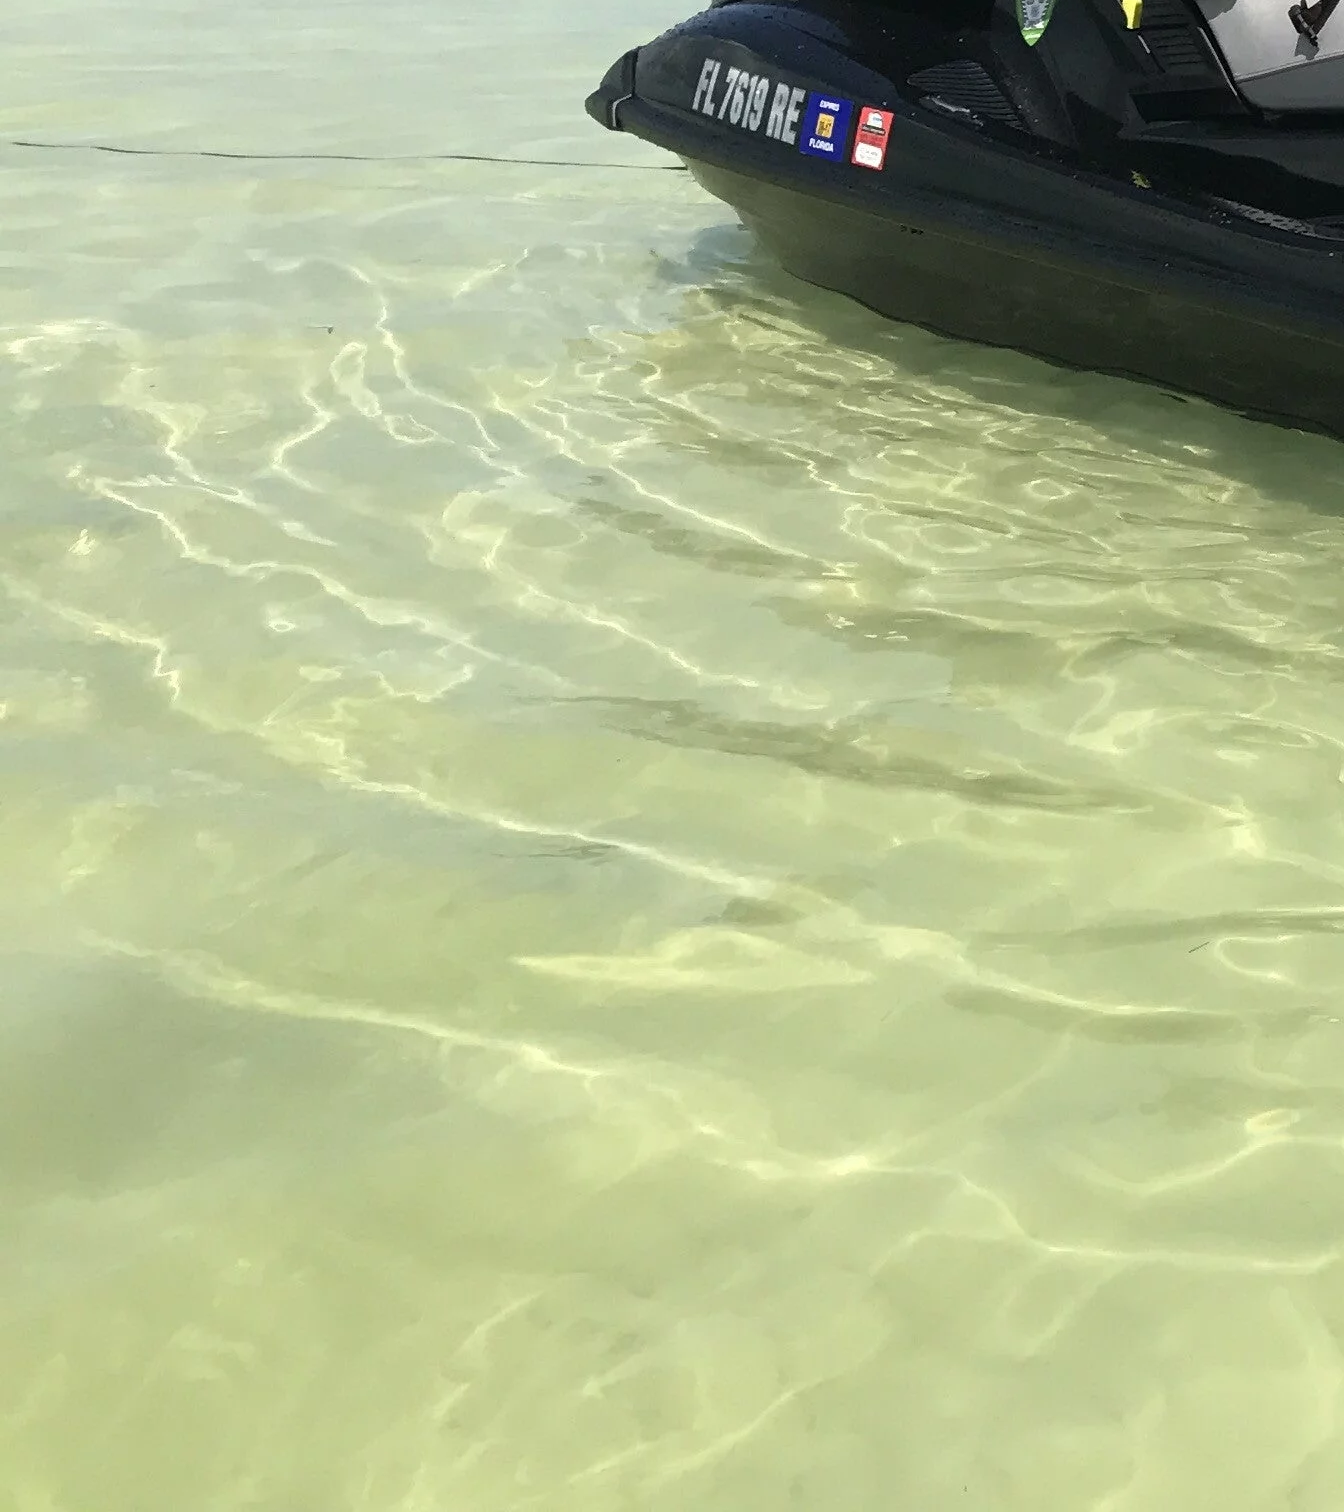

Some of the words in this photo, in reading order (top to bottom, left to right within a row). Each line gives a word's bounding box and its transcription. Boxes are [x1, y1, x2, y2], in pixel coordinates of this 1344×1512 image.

[692, 58, 722, 117] FL
[717, 66, 770, 132] 7619
[765, 82, 807, 145] RE
[808, 137, 834, 153] FLORIDA
